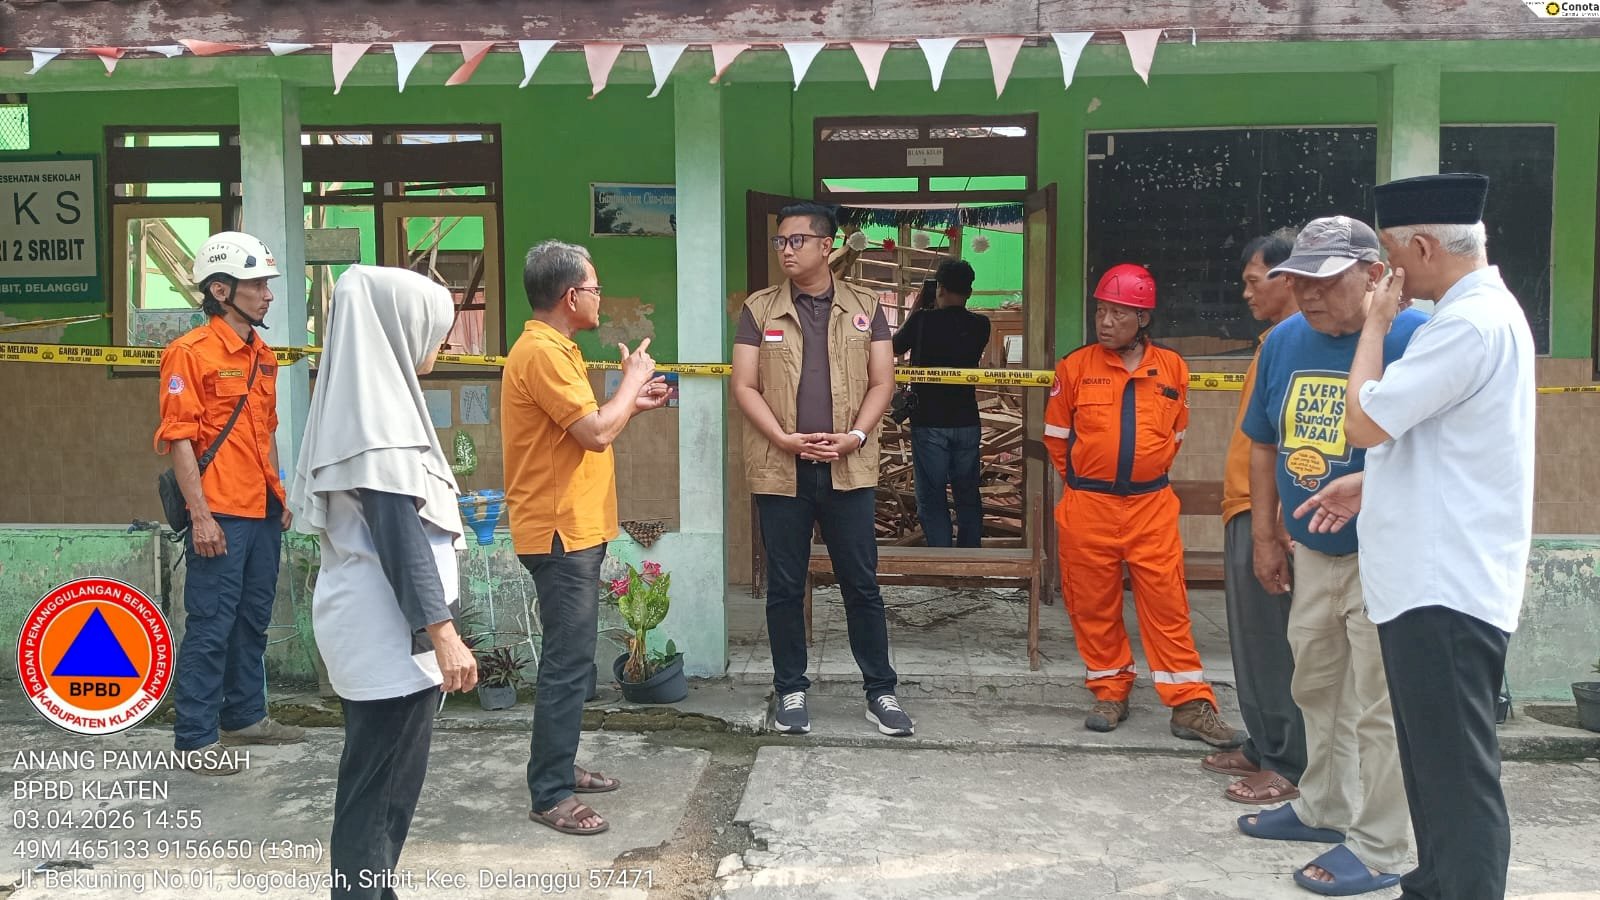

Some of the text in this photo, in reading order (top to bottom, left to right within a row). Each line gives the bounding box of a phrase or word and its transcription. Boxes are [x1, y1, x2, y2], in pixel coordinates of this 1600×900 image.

[42, 173, 81, 183] SEKOLAH
[13, 239, 23, 261] 2
[28, 238, 84, 261] SRIBIT
[25, 283, 89, 294] DELANGGU
[58, 346, 103, 357] GARIS POLISI
[122, 349, 155, 359] DILARANG
[1299, 384, 1346, 399] EVERY
[1296, 398, 1345, 415] DAY IS
